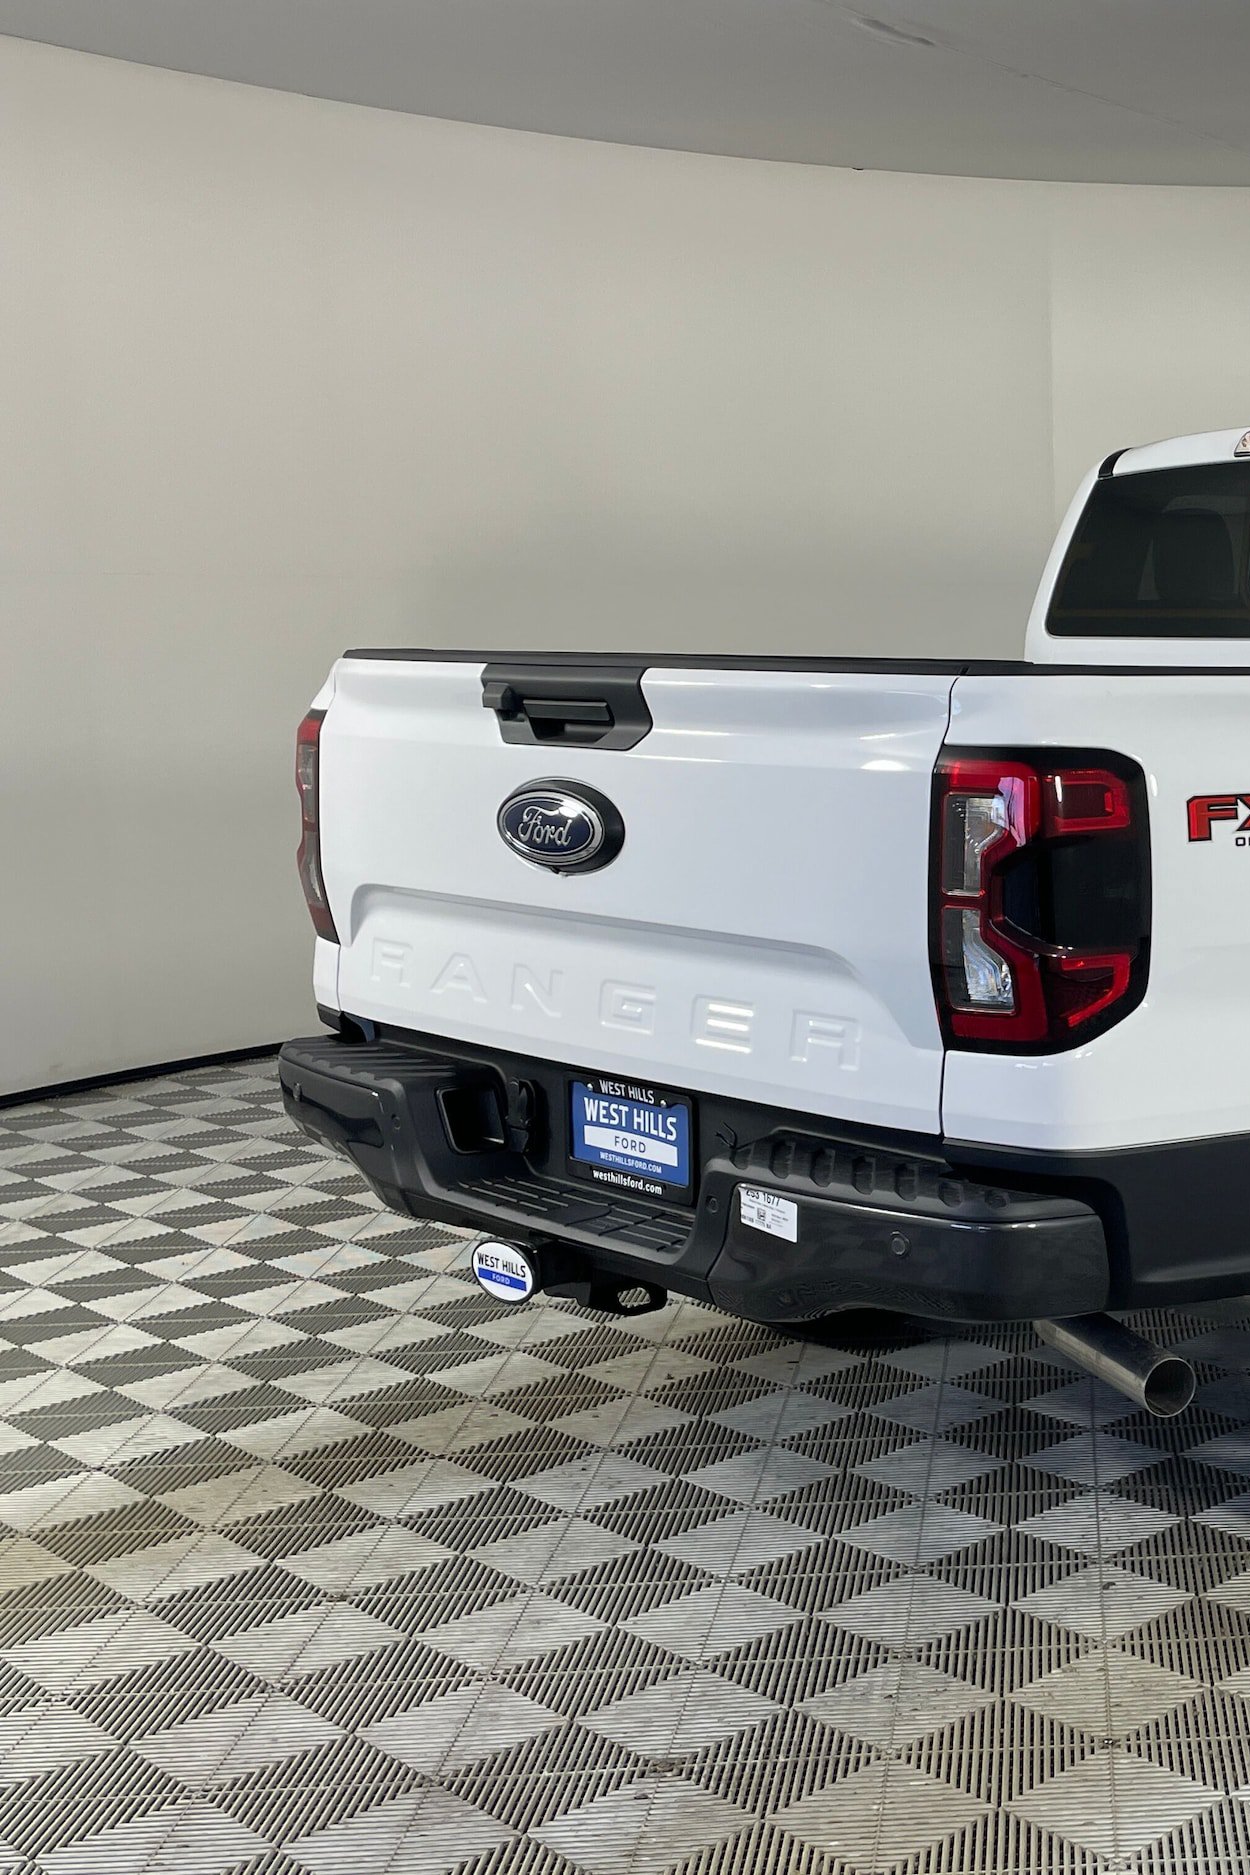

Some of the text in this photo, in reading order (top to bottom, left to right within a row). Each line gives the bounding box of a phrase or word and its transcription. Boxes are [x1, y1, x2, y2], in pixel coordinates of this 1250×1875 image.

[518, 806, 571, 847] Ford
[370, 938, 862, 1072] RANGER
[599, 1079, 655, 1105] WEST HILLS
[584, 1097, 677, 1142] WEST HILLS
[614, 1135, 646, 1154] FORD
[600, 1152, 662, 1174] WESTHILLSFORD.COM
[593, 1170, 662, 1195] westhillsford.com
[477, 1252, 526, 1278] WEST HILLS
[492, 1273, 511, 1284] FORD
